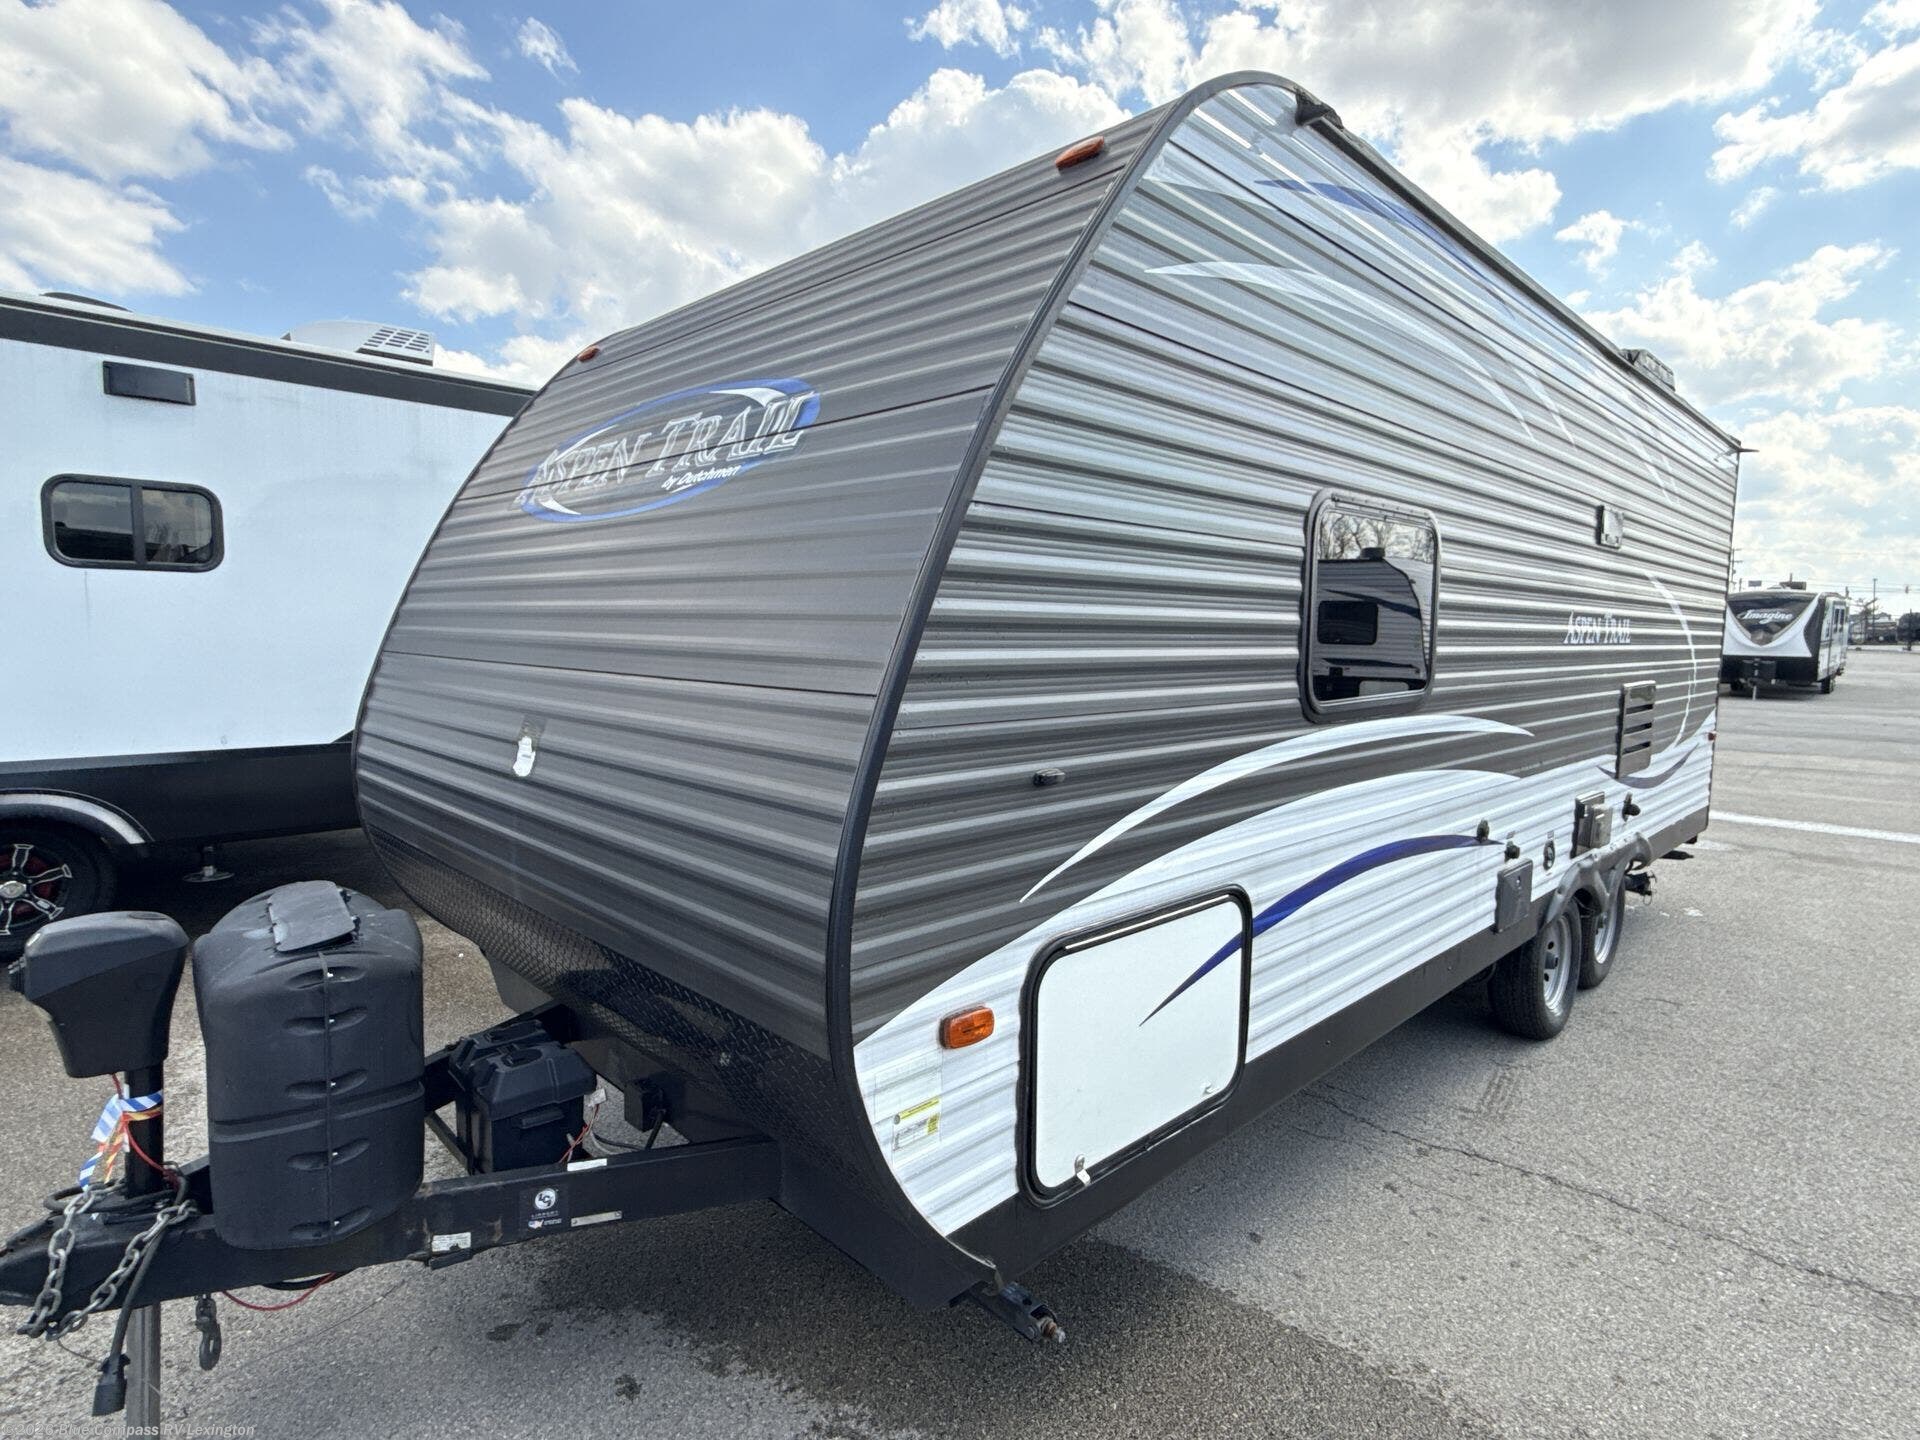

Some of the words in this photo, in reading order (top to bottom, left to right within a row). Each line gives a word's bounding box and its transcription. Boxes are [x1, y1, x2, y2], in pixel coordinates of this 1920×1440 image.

[513, 432, 652, 506] ASPEN
[645, 391, 817, 477] TRAIL
[661, 476, 679, 490] by
[1563, 609, 1601, 645] ASPEN
[1603, 612, 1632, 645] TRAIL
[1742, 609, 1794, 624] Imagine
